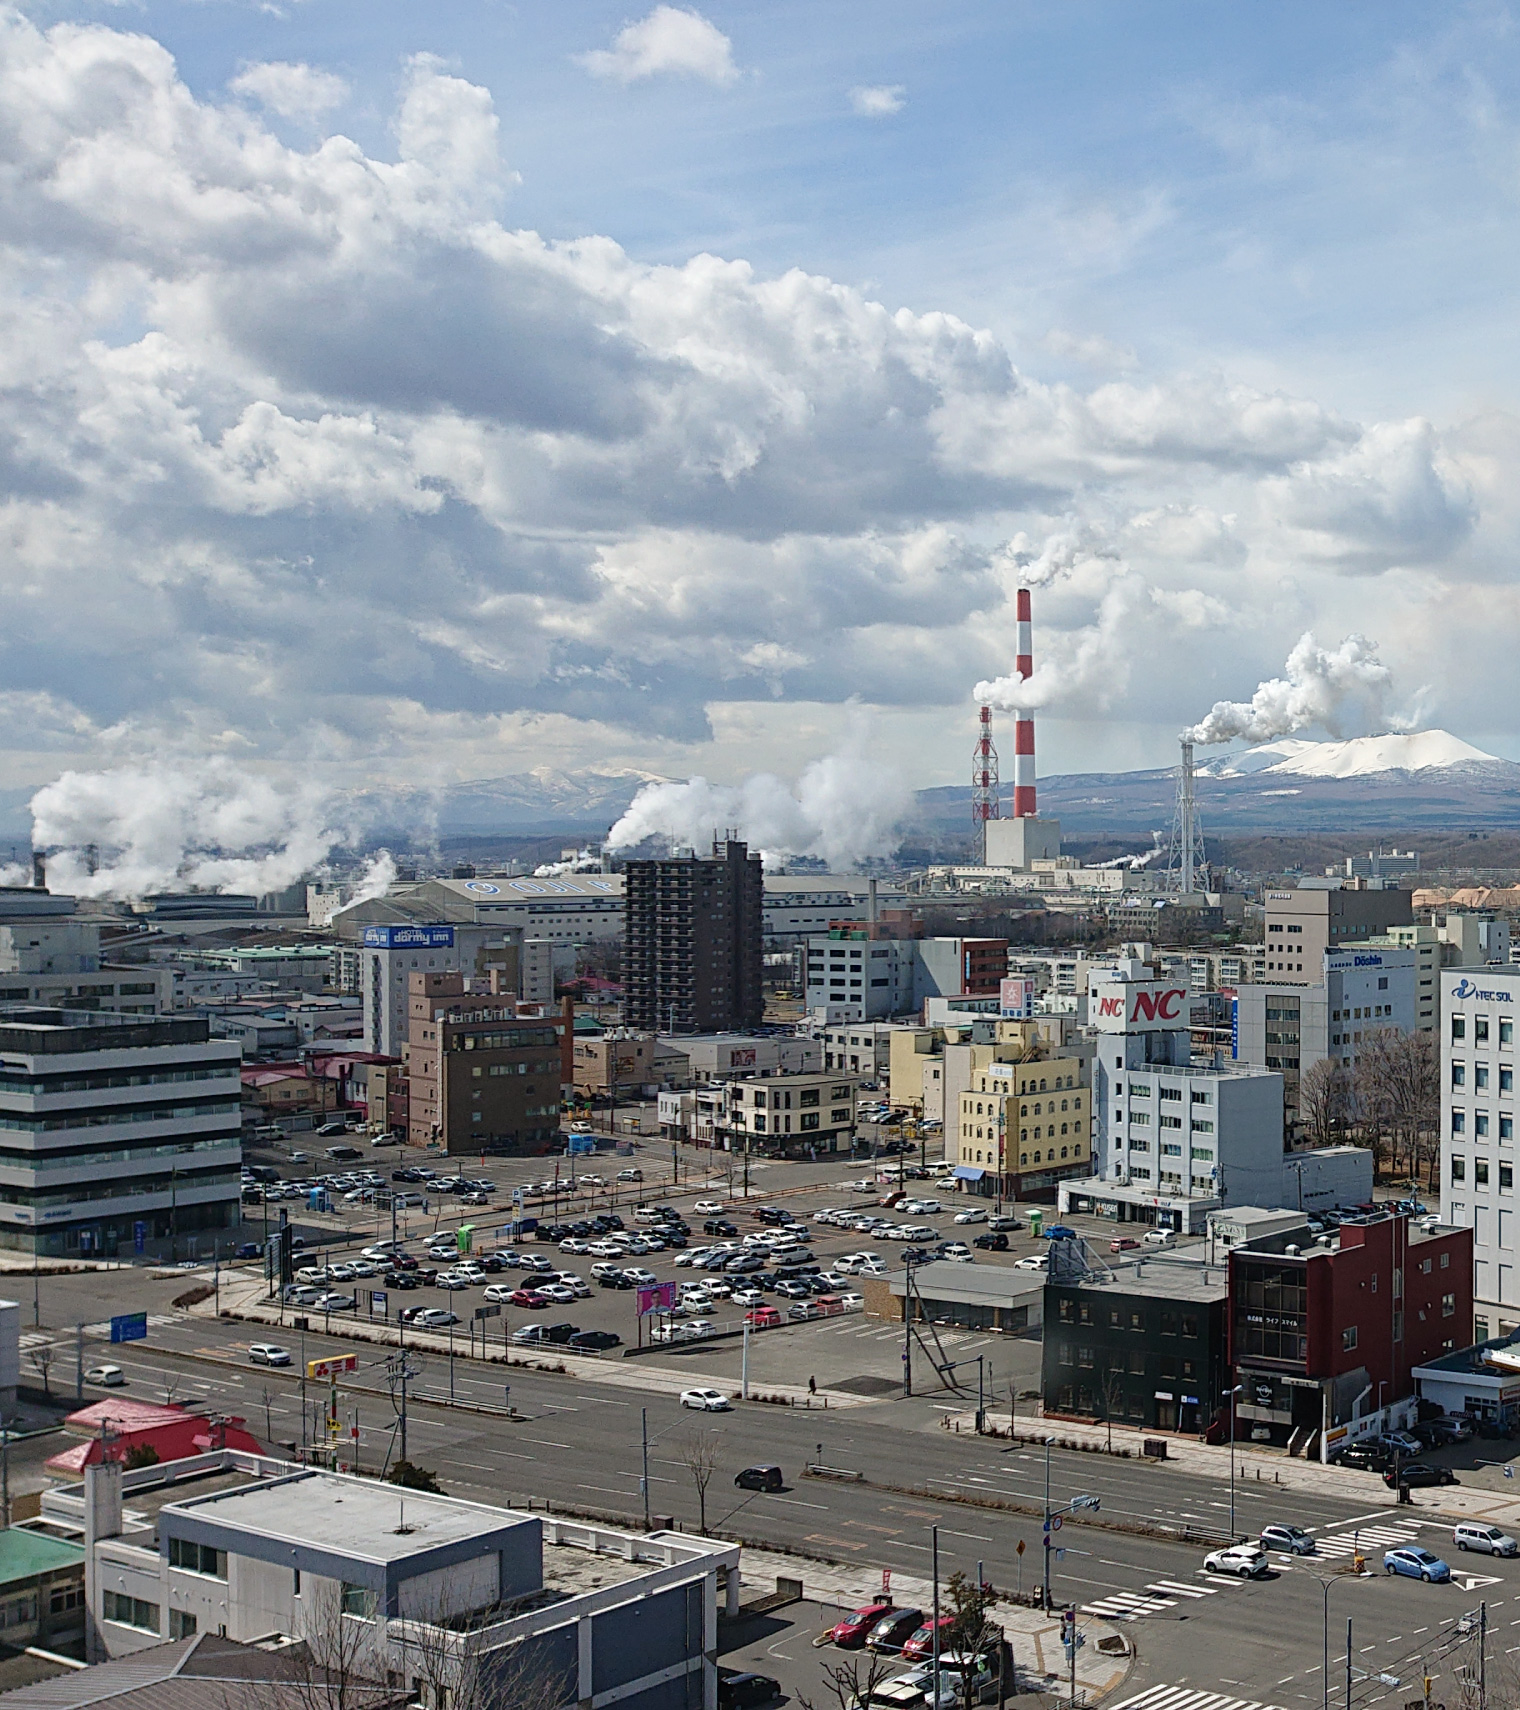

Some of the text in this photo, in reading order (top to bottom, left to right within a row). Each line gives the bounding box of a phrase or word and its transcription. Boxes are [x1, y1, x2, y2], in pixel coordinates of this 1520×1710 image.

[508, 880, 586, 893] OJI
[393, 931, 449, 945] dormy inn
[1495, 991, 1514, 1003] SOL
[1098, 997, 1125, 1018] NC
[1129, 989, 1187, 1023] NC
[1281, 1319, 1298, 1327] スマイル
